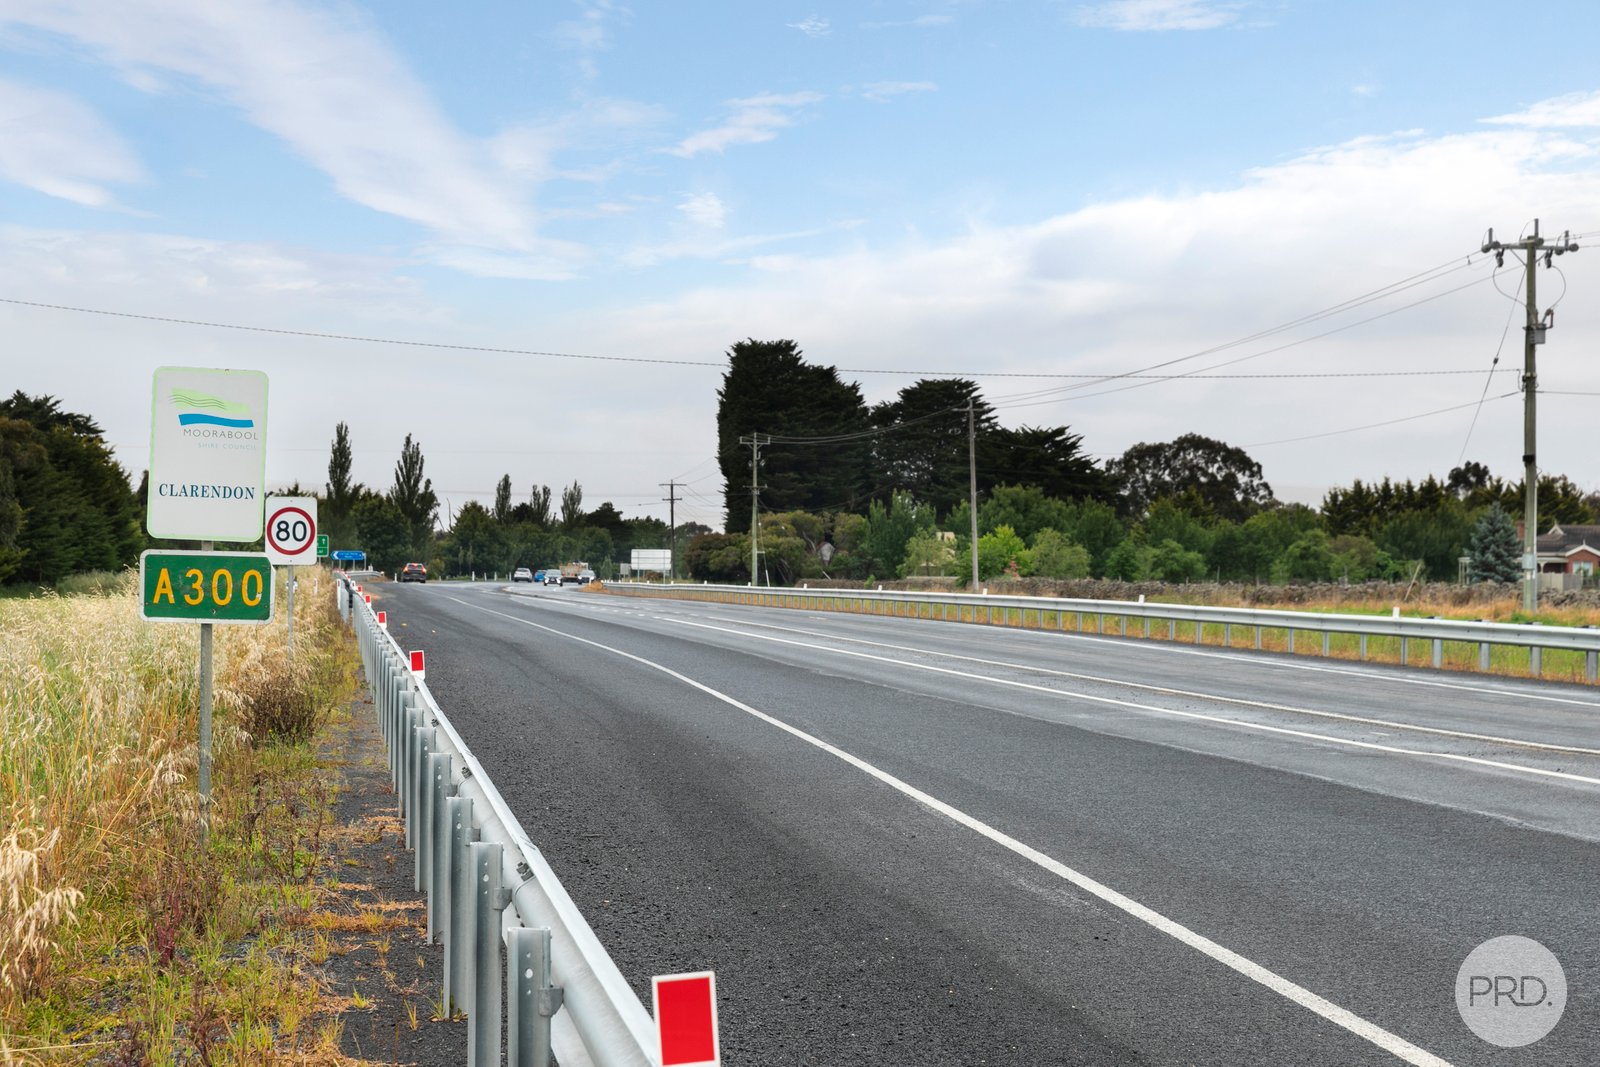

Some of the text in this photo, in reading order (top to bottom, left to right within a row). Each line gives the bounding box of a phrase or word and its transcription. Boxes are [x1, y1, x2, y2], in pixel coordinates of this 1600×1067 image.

[183, 429, 259, 440] MOORABOOL
[159, 483, 255, 500] CLARENDON
[276, 520, 307, 542] 80
[152, 568, 263, 607] A300
